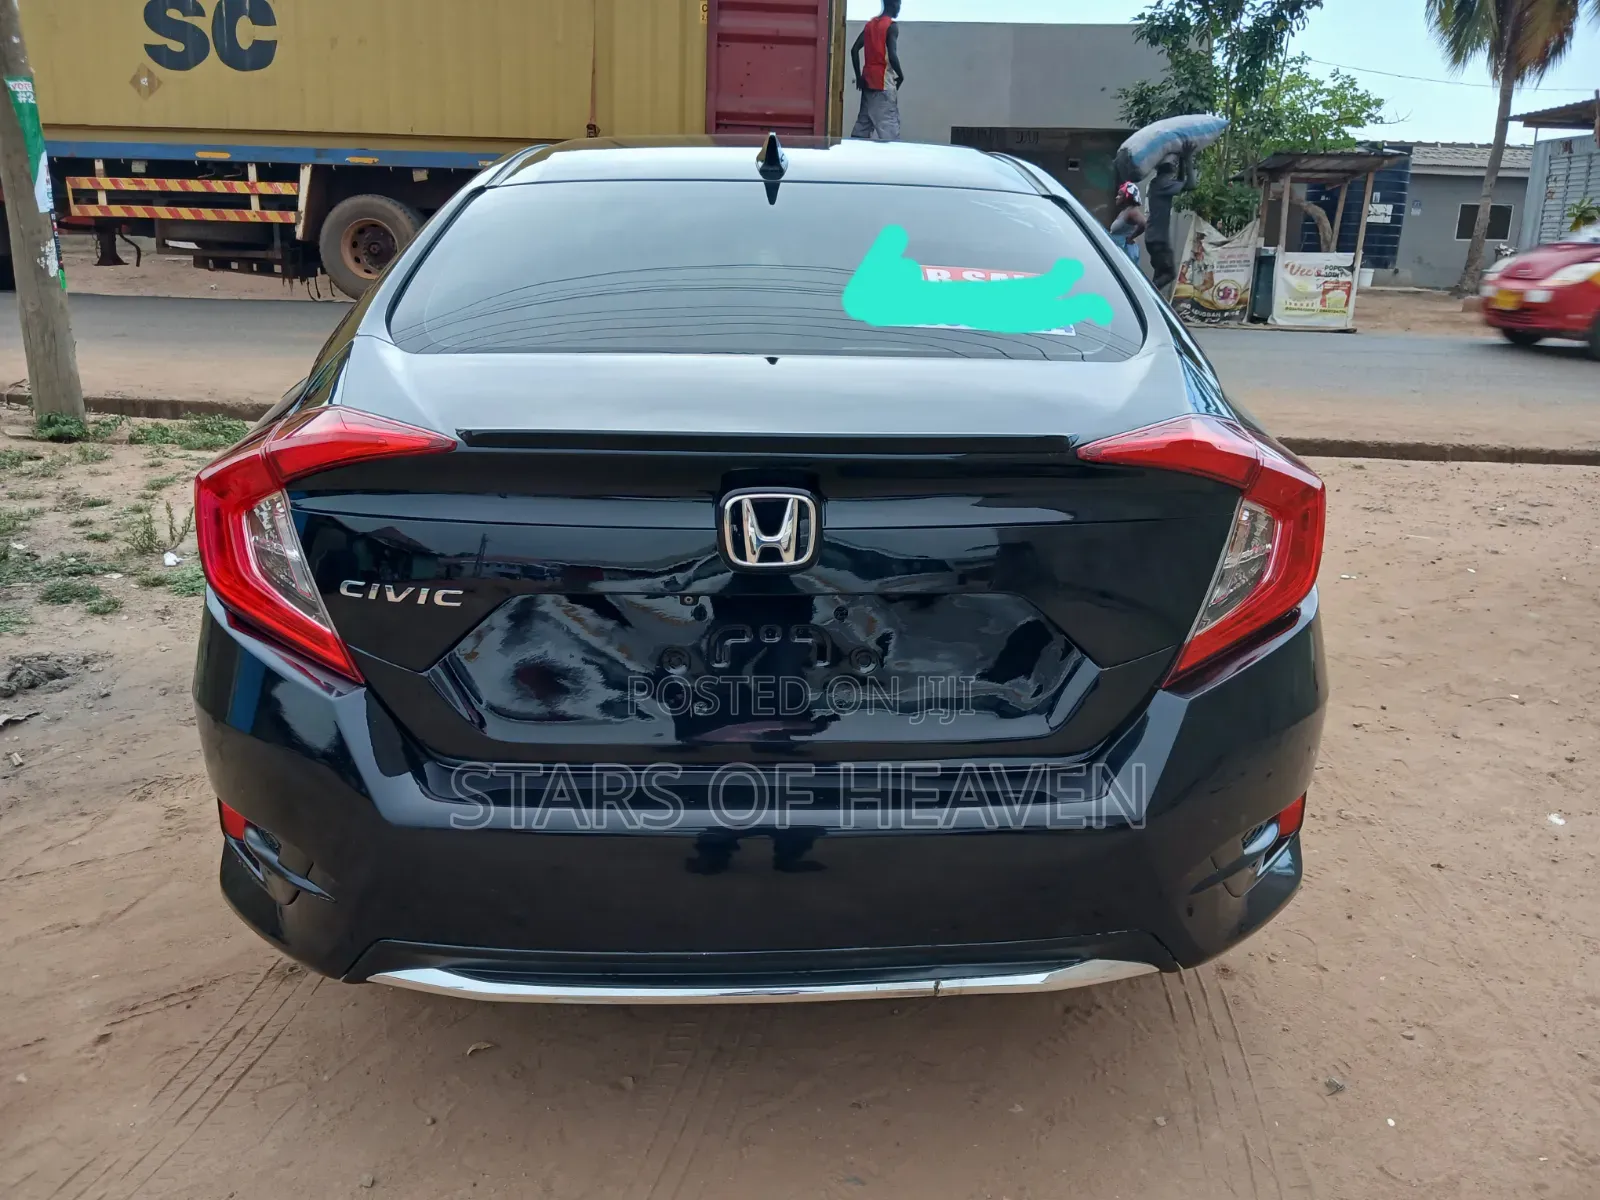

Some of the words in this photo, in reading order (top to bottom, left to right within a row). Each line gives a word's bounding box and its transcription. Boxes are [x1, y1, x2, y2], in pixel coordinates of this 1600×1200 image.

[143, 0, 277, 71] SC
[11, 82, 33, 91] VOTE
[339, 579, 464, 607] CIVIC
